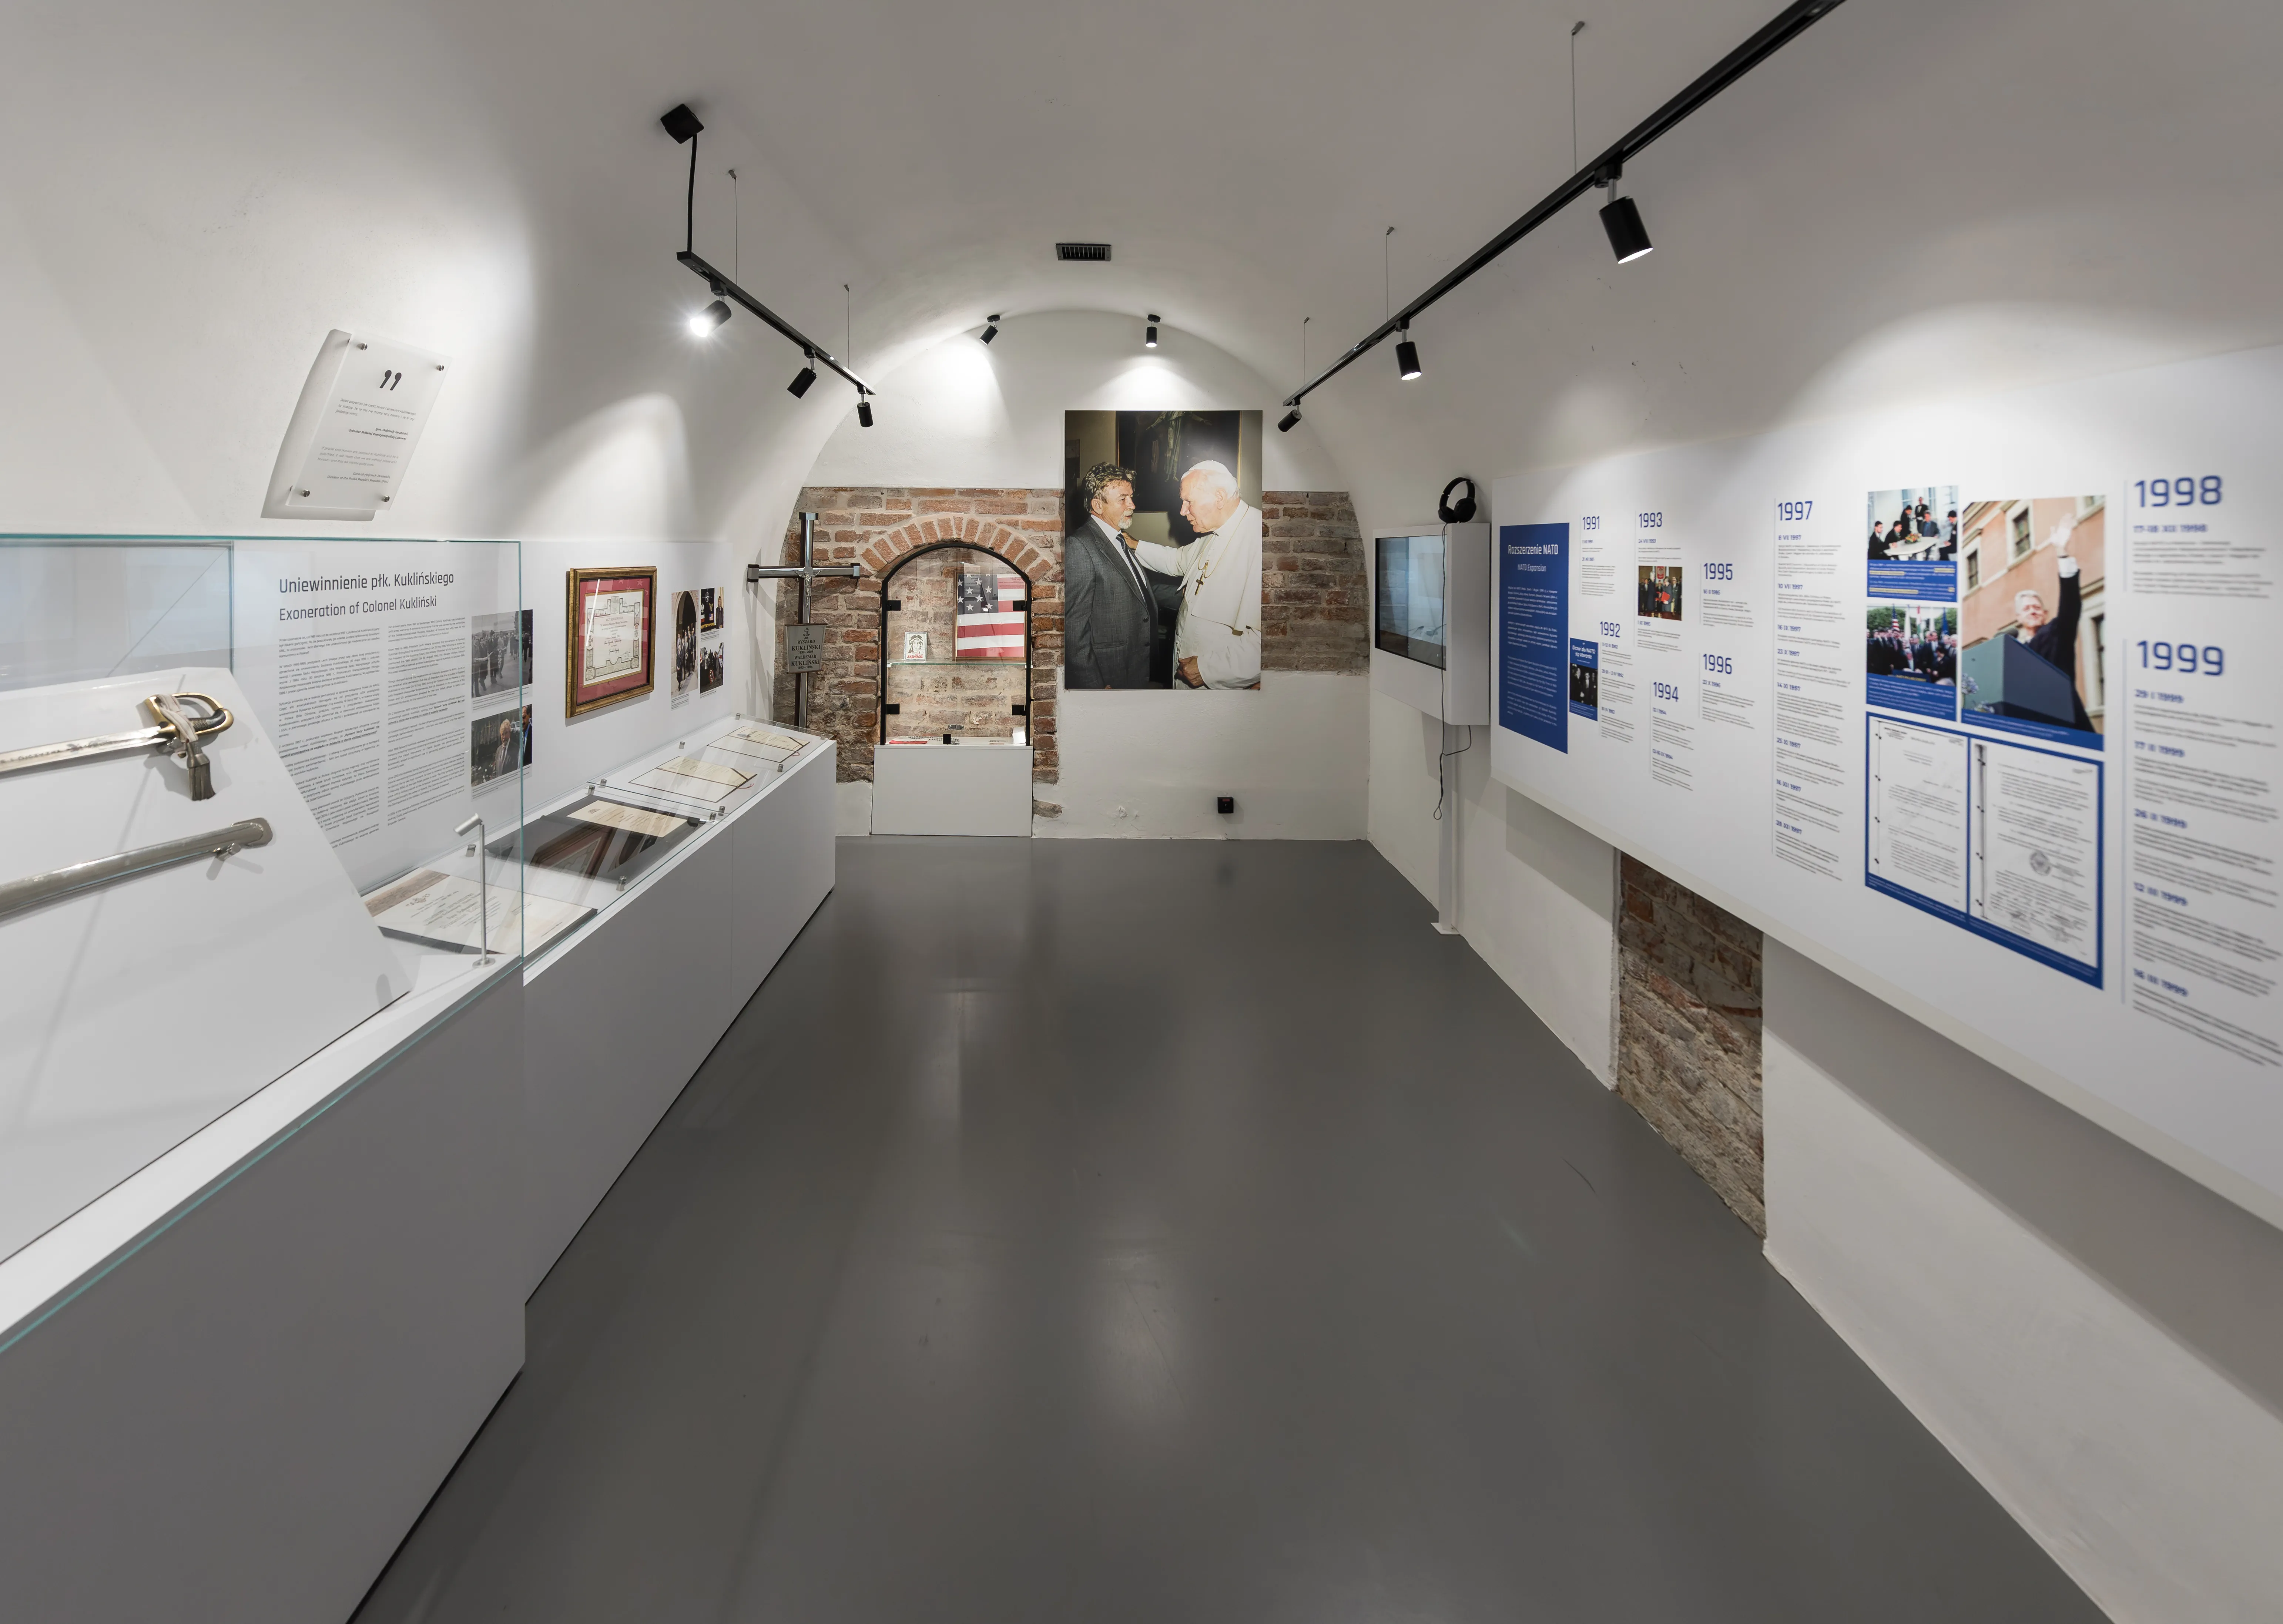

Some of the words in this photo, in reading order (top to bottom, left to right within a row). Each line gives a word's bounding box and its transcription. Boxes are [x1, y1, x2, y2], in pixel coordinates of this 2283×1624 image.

[2134, 475, 2223, 507] 1998
[1778, 501, 1813, 520] 1997
[1583, 516, 1600, 530] 1991
[1639, 512, 1662, 528] 1993
[1508, 544, 1542, 554] Rozszerzenie
[1543, 544, 1558, 554] NATO
[1704, 563, 1733, 580] 1995
[280, 575, 367, 593] Uniewinnienie
[372, 574, 390, 590] płk.
[395, 572, 453, 586] Kuklińskiego
[280, 604, 345, 620] Exoneration
[350, 602, 359, 614] of
[363, 599, 396, 613] Colonel
[400, 595, 436, 609] Kukliński
[1600, 621, 1620, 637] 1992
[1703, 654, 1732, 674] 1996
[2137, 640, 2224, 676] 1999
[1653, 682, 1679, 701] 1994
[1790, 741, 1801, 749] 1997
[1790, 784, 1801, 792] 1997
[1791, 826, 1803, 835] 1997
